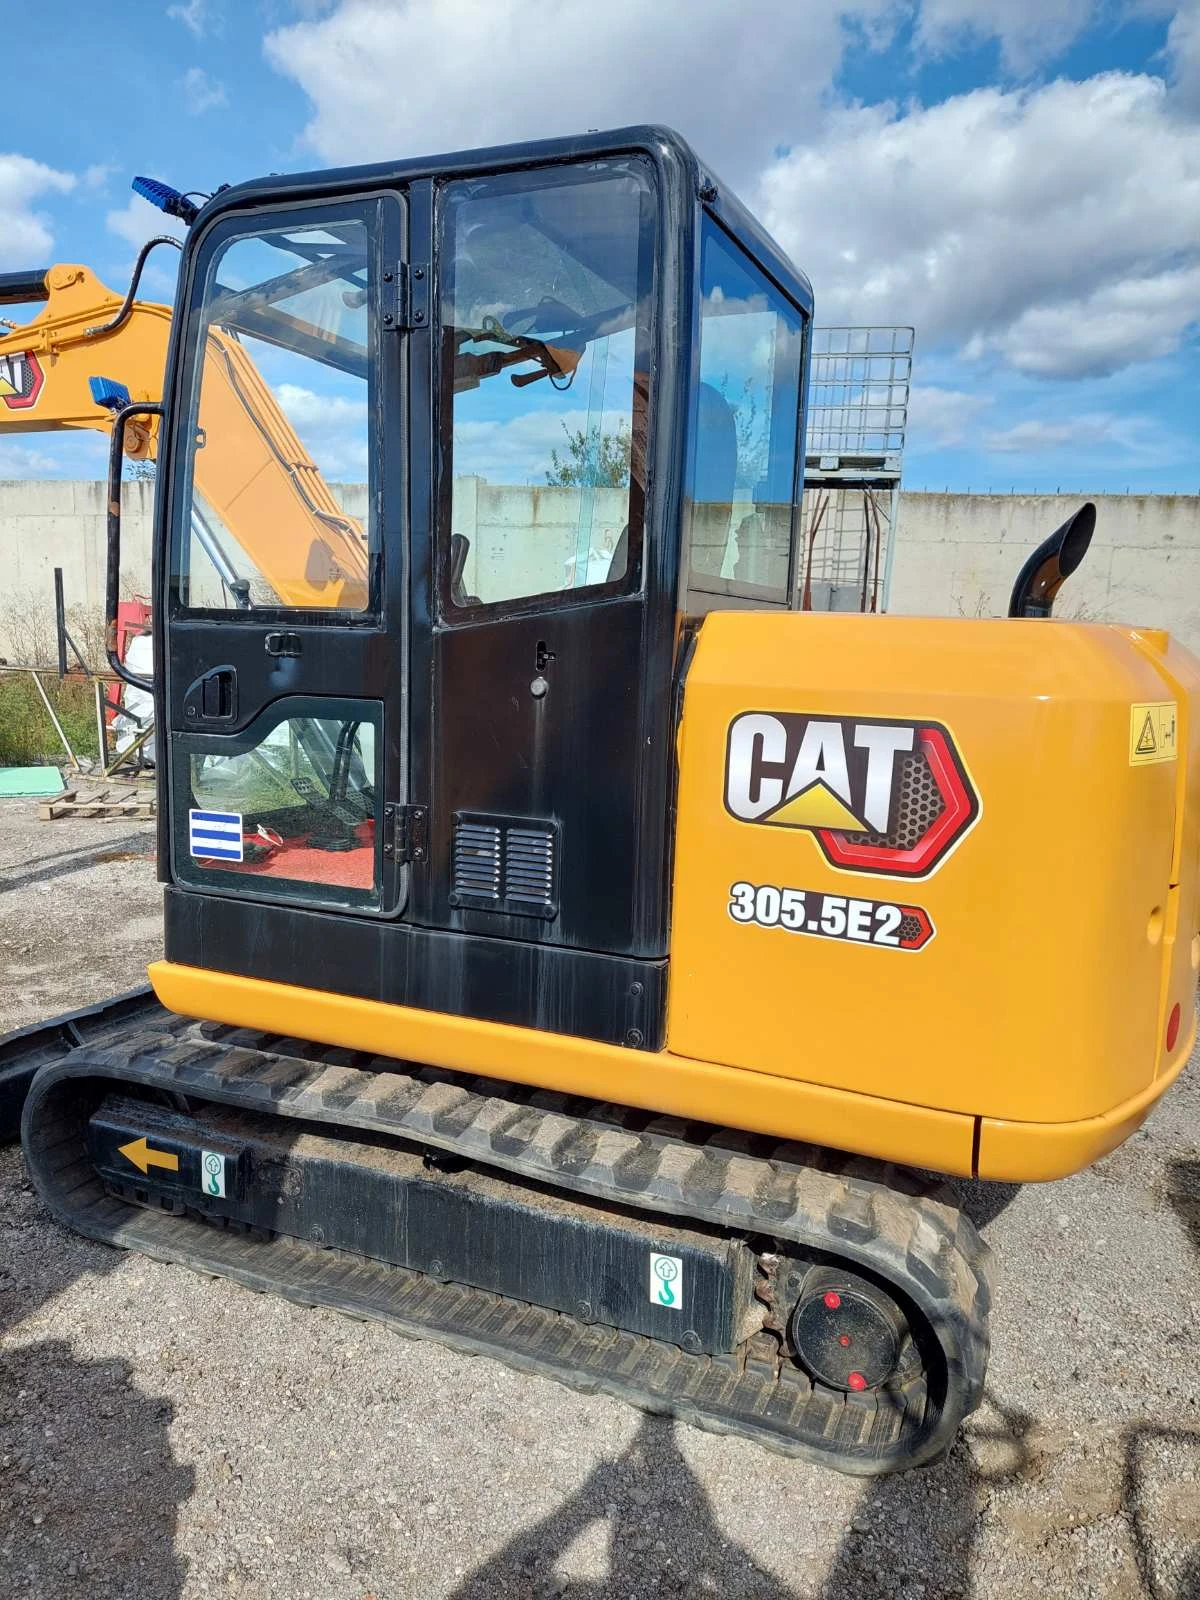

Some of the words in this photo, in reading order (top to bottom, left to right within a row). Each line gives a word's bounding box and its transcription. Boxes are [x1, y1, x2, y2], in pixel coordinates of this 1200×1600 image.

[0, 351, 25, 393] AT
[728, 713, 915, 834] CAT
[730, 882, 902, 945] 305.5E2
